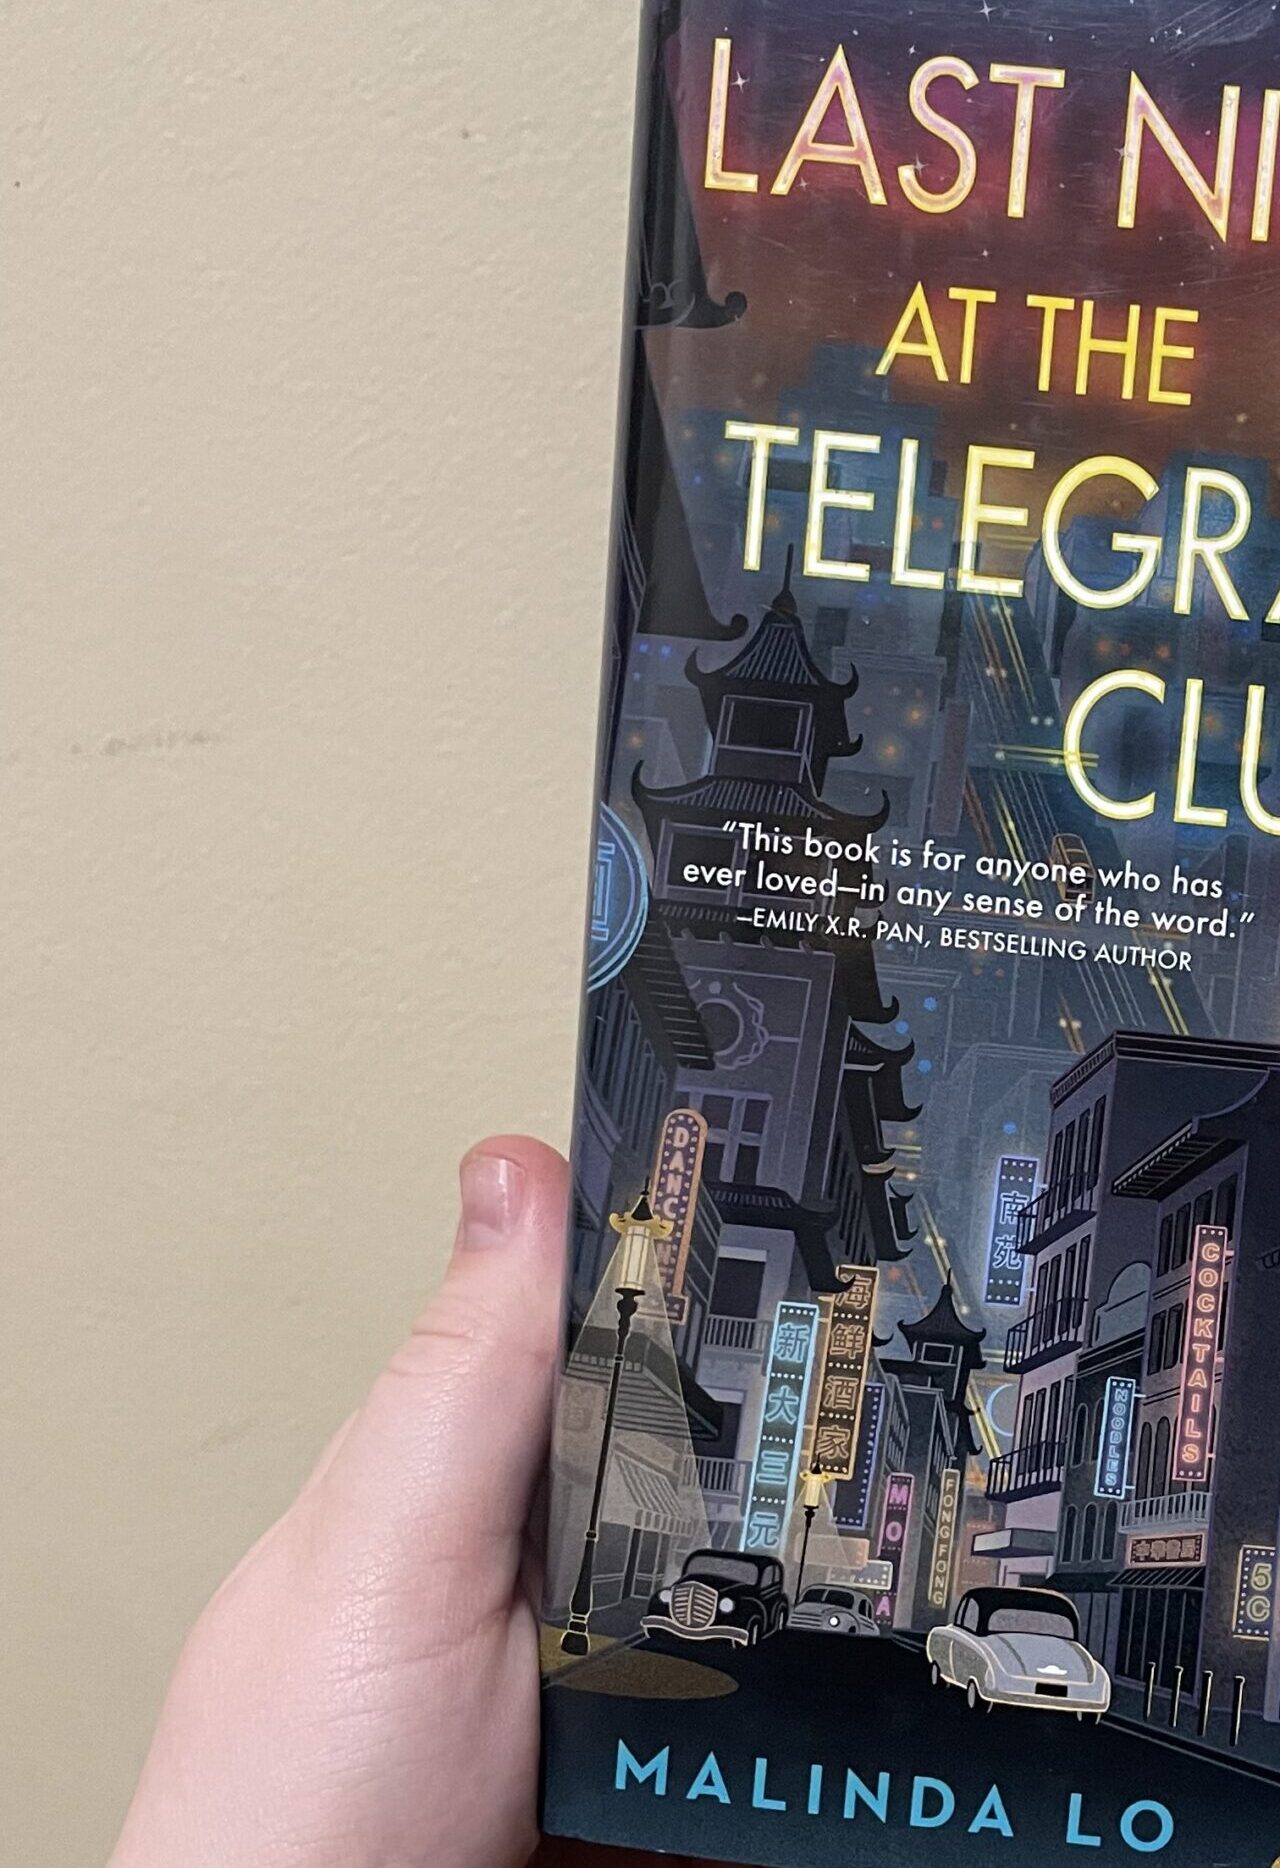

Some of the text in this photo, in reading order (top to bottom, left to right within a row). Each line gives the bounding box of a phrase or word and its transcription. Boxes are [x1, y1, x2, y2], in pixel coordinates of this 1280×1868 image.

[704, 38, 1066, 218] LAST
[875, 281, 1198, 405] AT THE
[683, 864, 747, 887] ever
[897, 886, 953, 916] any
[962, 893, 1043, 919] sense
[1054, 894, 1088, 923] of
[1095, 896, 1140, 928] the
[804, 827, 880, 864] book
[891, 839, 912, 867] is
[923, 840, 966, 872] for
[975, 854, 1087, 886] anyone
[1098, 859, 1161, 892] who
[1172, 864, 1223, 898] has
[825, 915, 867, 938] X.R.
[876, 920, 931, 948] PAN,
[940, 927, 1087, 961] BESTSELLING
[1094, 942, 1192, 972] AUTHOR
[1182, 1242, 1221, 1463] COCKTAILS
[747, 1321, 811, 1549] 新大三元
[1104, 1388, 1129, 1487] NOODLES
[615, 1738, 1175, 1853] MALINDA LO
